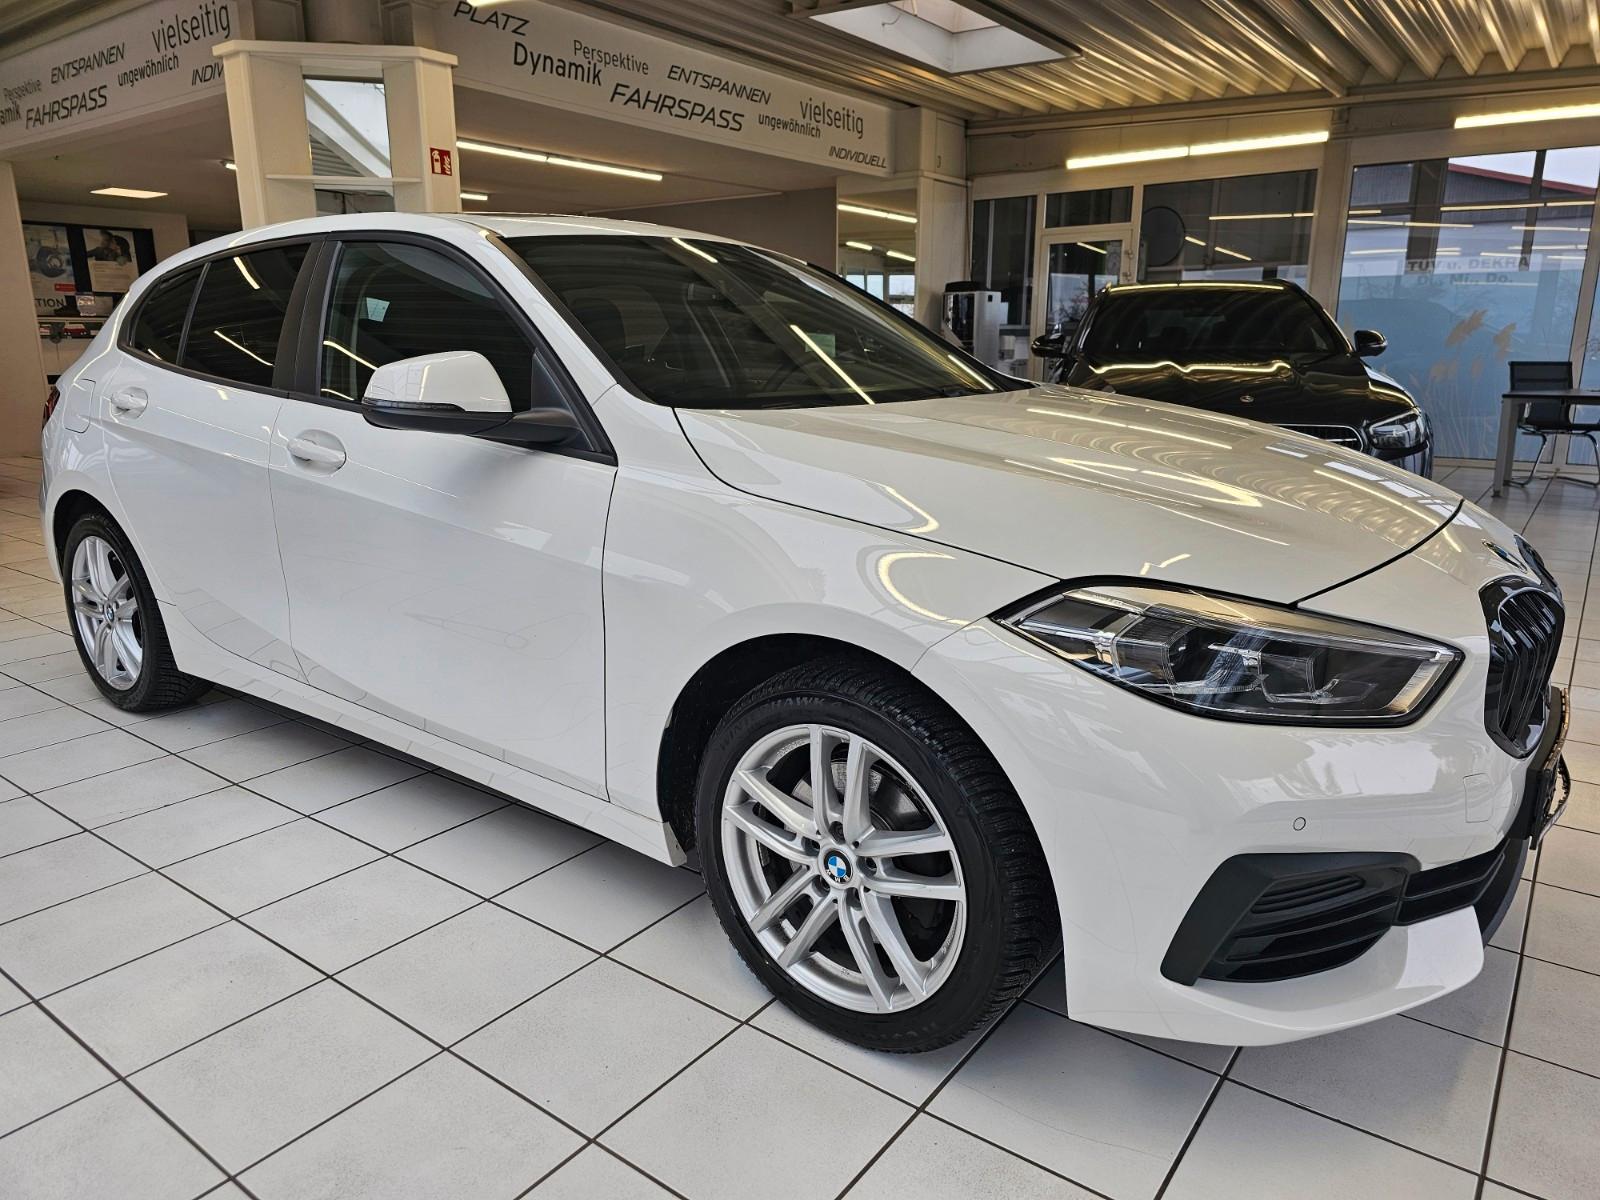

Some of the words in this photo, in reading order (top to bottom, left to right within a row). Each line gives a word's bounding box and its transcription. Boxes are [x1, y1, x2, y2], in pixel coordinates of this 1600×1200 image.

[152, 0, 231, 54] vielseitig
[453, 1, 531, 37] PLATZ
[50, 42, 125, 85] ENTSPANNEN
[118, 52, 180, 88] ungewöhnlich
[513, 41, 602, 87] Dynamik
[573, 39, 650, 76] Perspektive
[667, 64, 772, 106] ENTSPANNEN
[25, 84, 108, 130] FAHRSPASS
[609, 82, 745, 132] FAHRSPASS
[758, 113, 821, 139] ungewöhnlich
[800, 97, 864, 140] vielseitig
[828, 145, 888, 169] INDIVIDUELL
